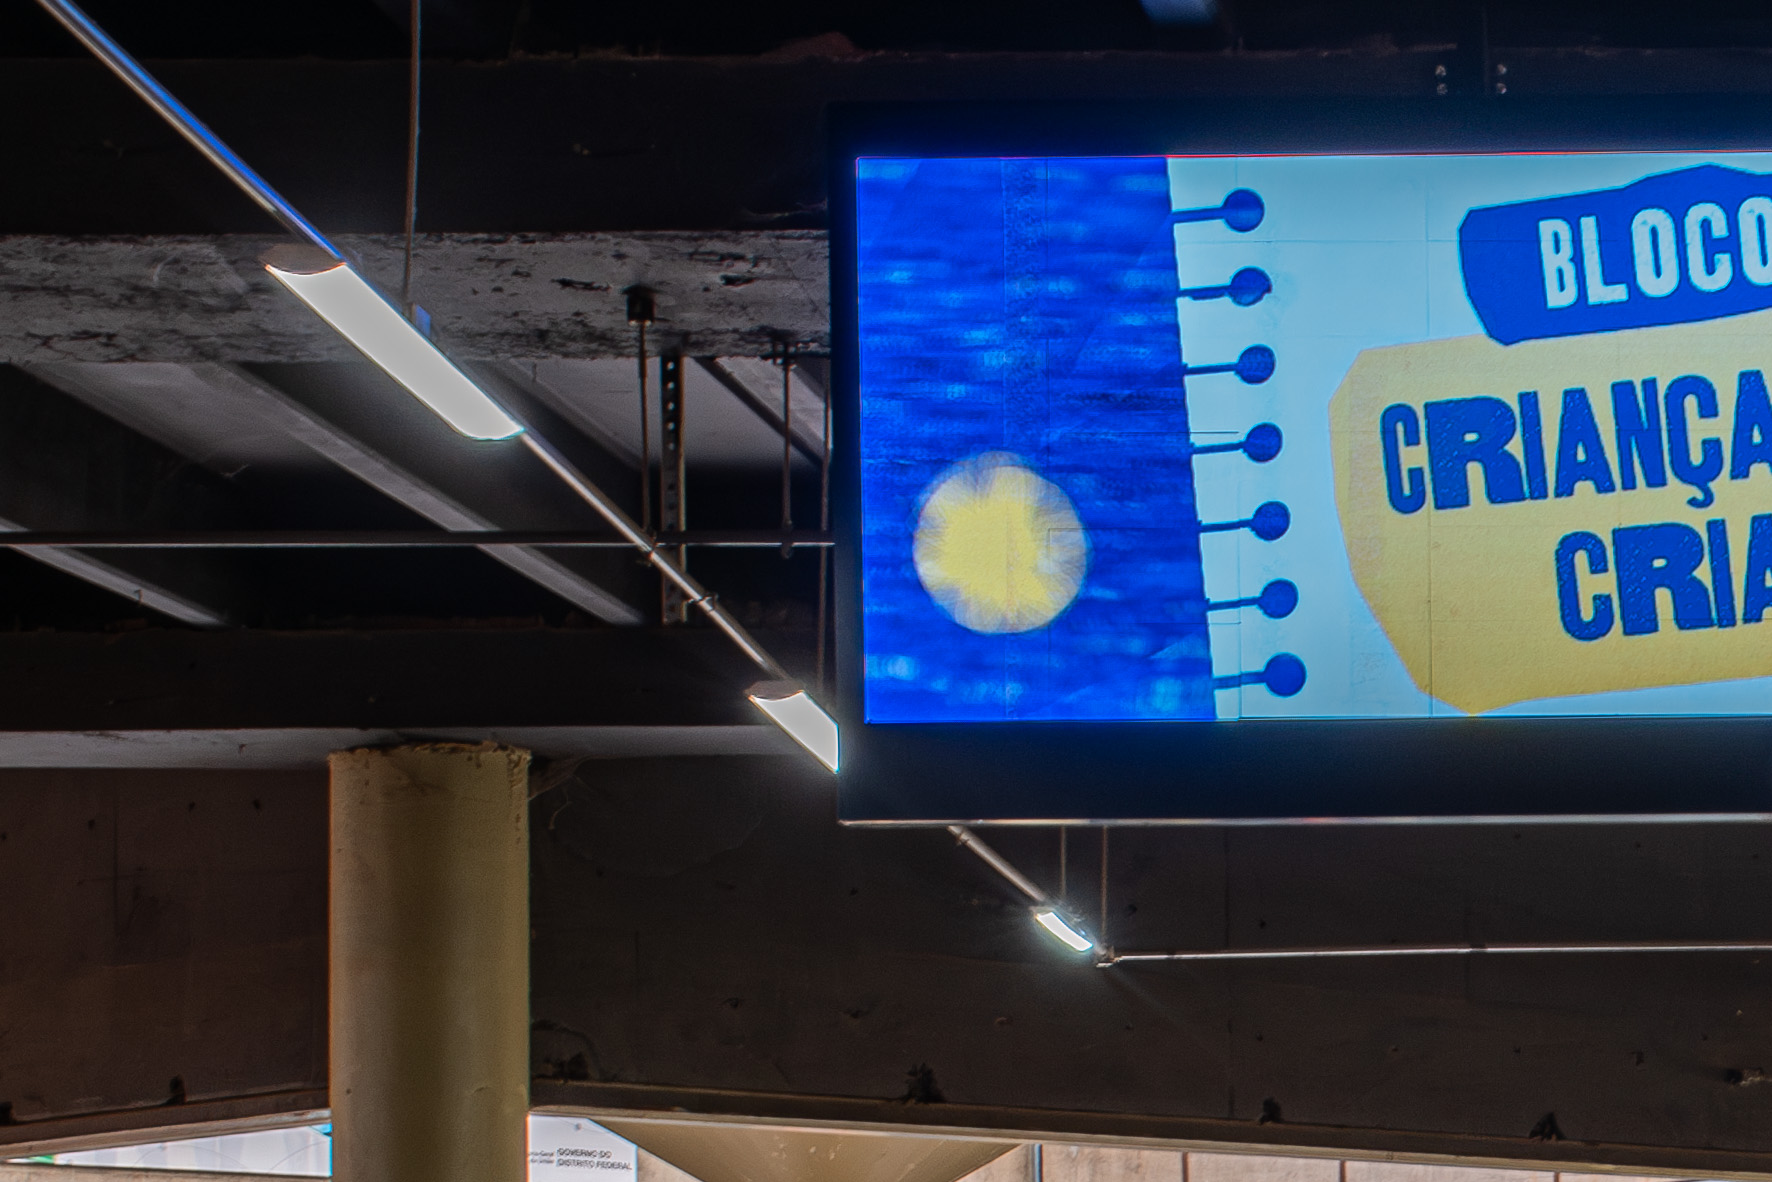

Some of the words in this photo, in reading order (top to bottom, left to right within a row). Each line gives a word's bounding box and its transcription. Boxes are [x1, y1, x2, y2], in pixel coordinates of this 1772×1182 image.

[557, 1148, 598, 1158] GOVERNO
[557, 1158, 595, 1169] DISTRITO
[596, 1161, 633, 1170] FEDERAL
